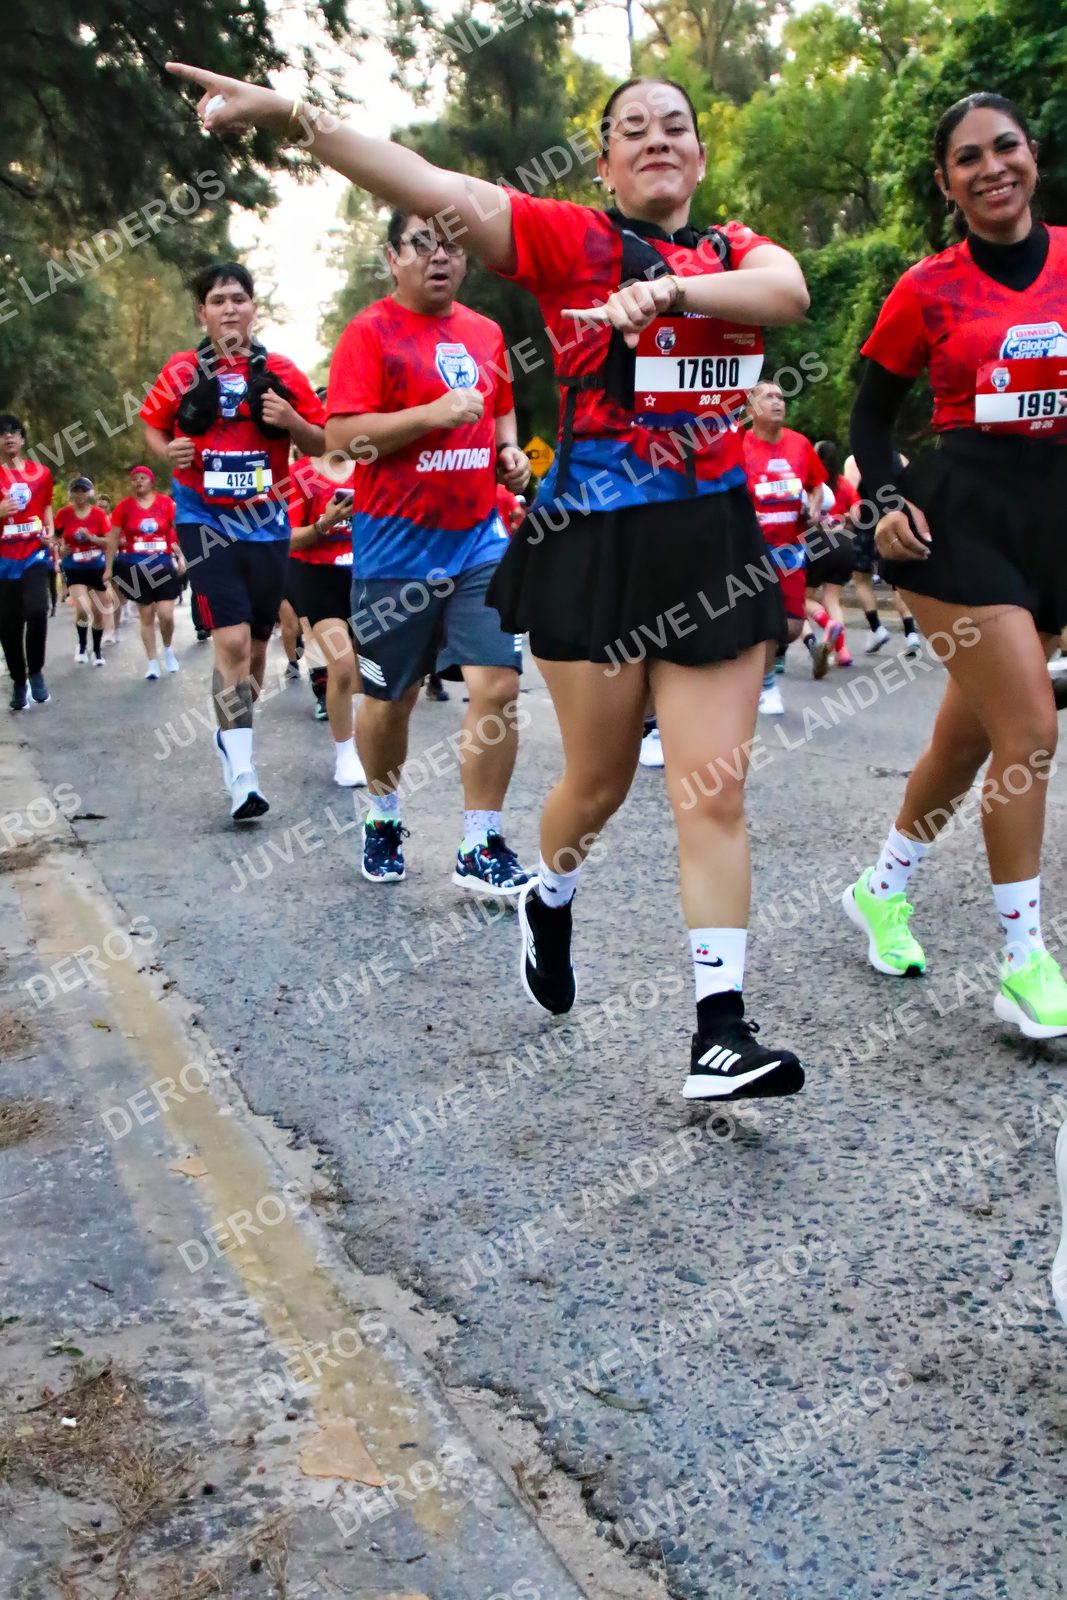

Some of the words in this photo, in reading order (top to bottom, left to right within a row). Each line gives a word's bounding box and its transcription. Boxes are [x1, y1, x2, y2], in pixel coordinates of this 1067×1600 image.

[1018, 338, 1057, 352] Global
[677, 357, 739, 389] 17600
[416, 447, 490, 472] SANTIAGO
[227, 473, 254, 488] 4124
